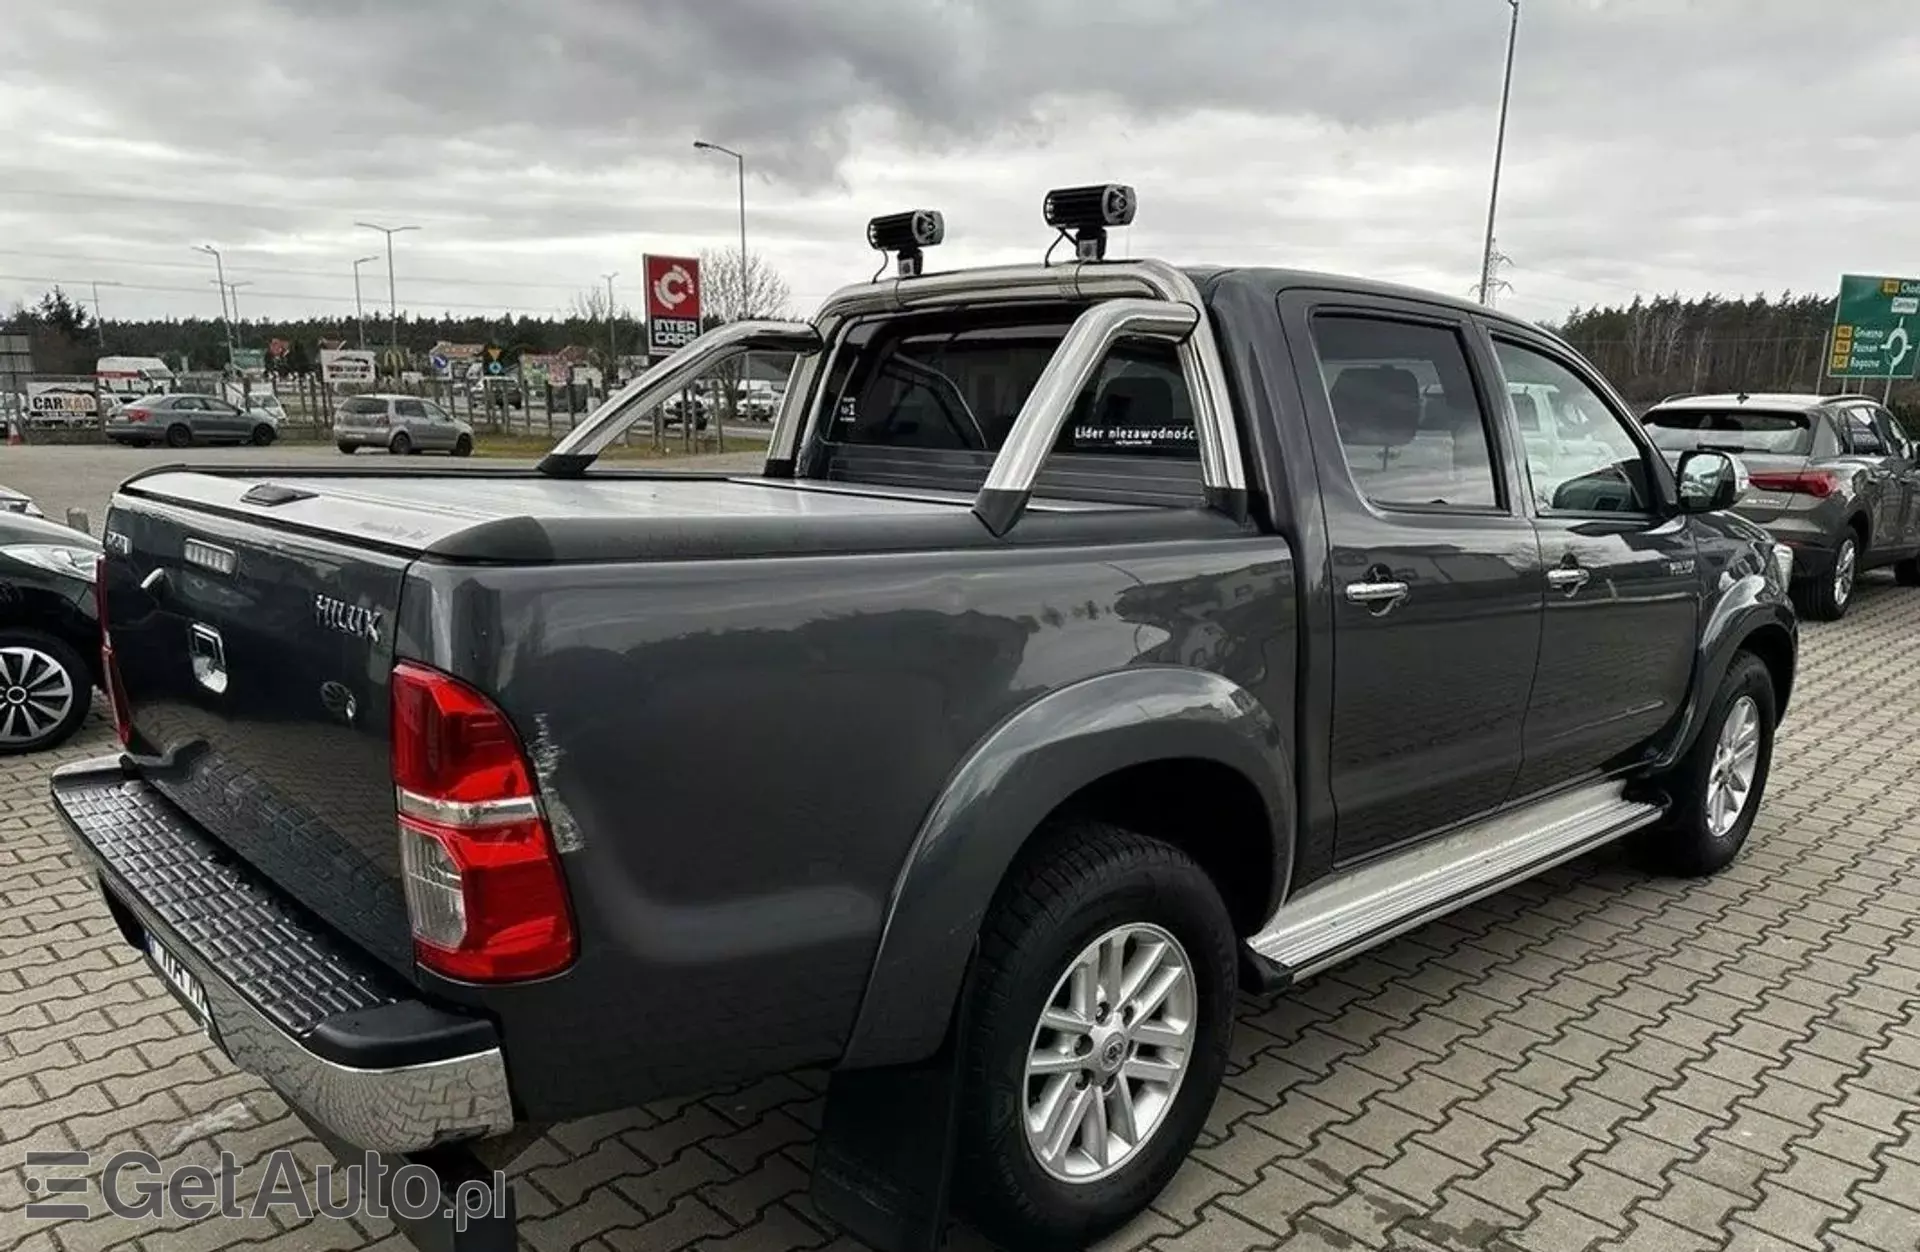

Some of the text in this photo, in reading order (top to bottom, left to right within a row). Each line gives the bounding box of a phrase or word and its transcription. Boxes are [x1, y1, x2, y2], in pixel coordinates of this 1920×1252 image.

[655, 320, 697, 333] INTER
[1075, 425, 1195, 440] Lider niezawodnośc
